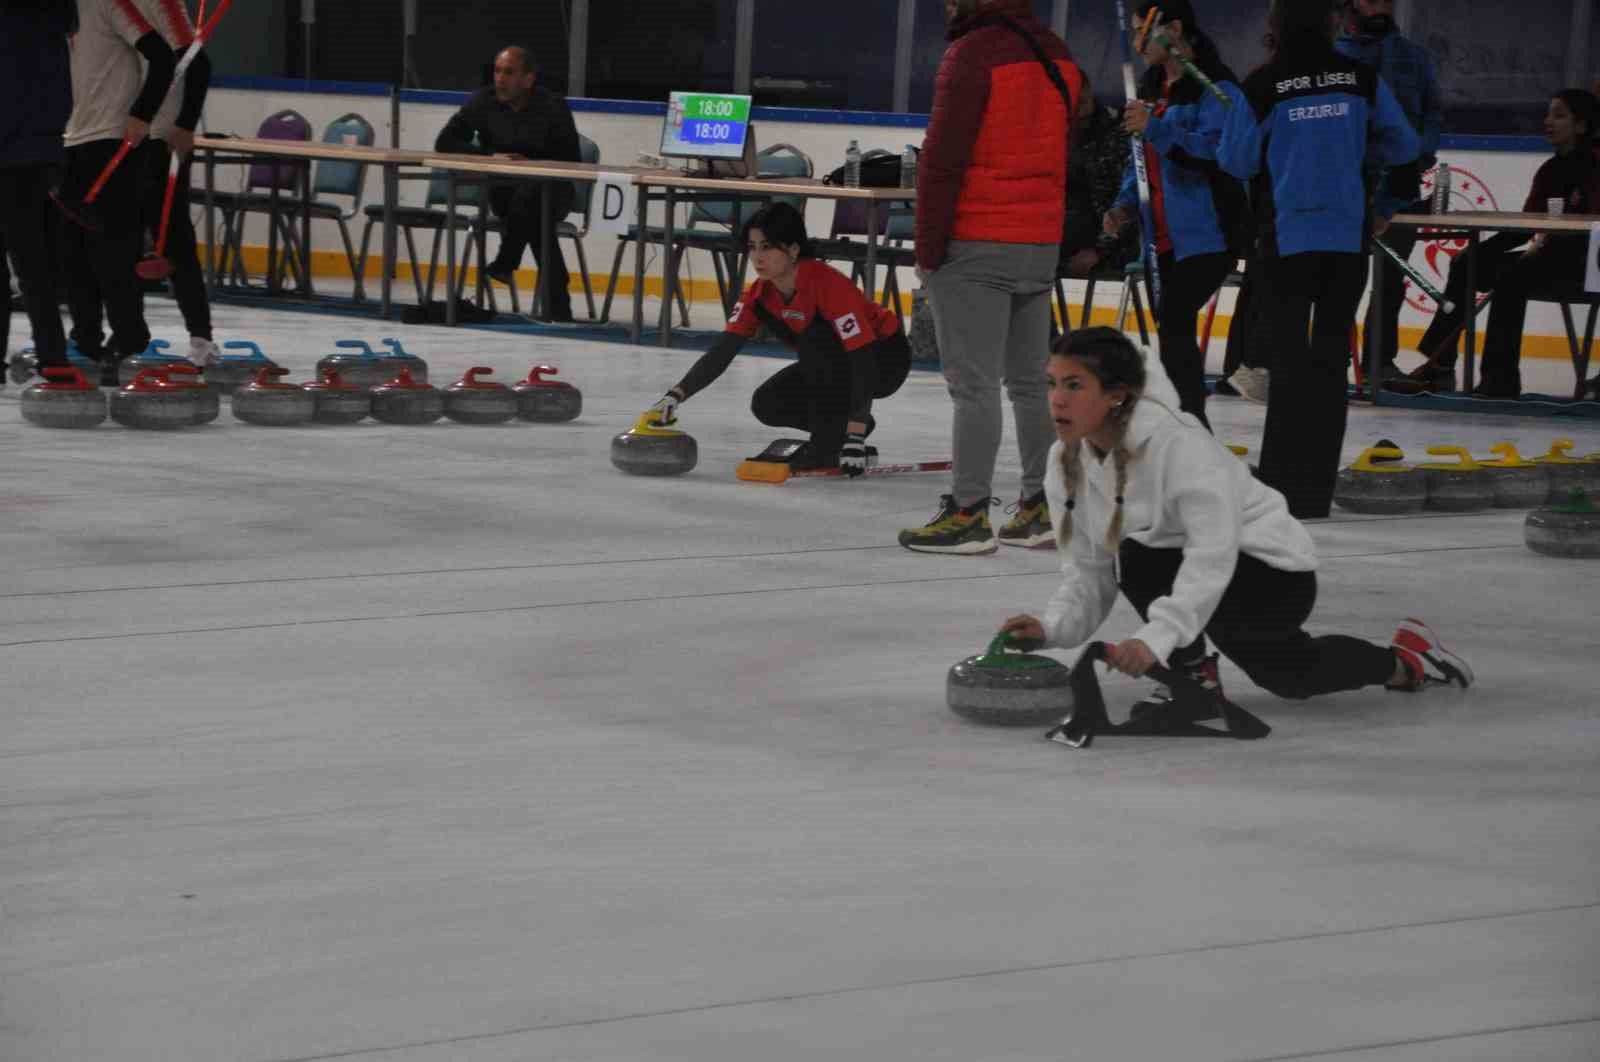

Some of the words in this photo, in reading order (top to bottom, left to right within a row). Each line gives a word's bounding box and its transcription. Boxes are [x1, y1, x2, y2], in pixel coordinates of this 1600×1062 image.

[1276, 76, 1311, 93] SPOR
[699, 100, 733, 116] 18:00
[695, 123, 729, 139] 18:00
[603, 184, 624, 220] D
